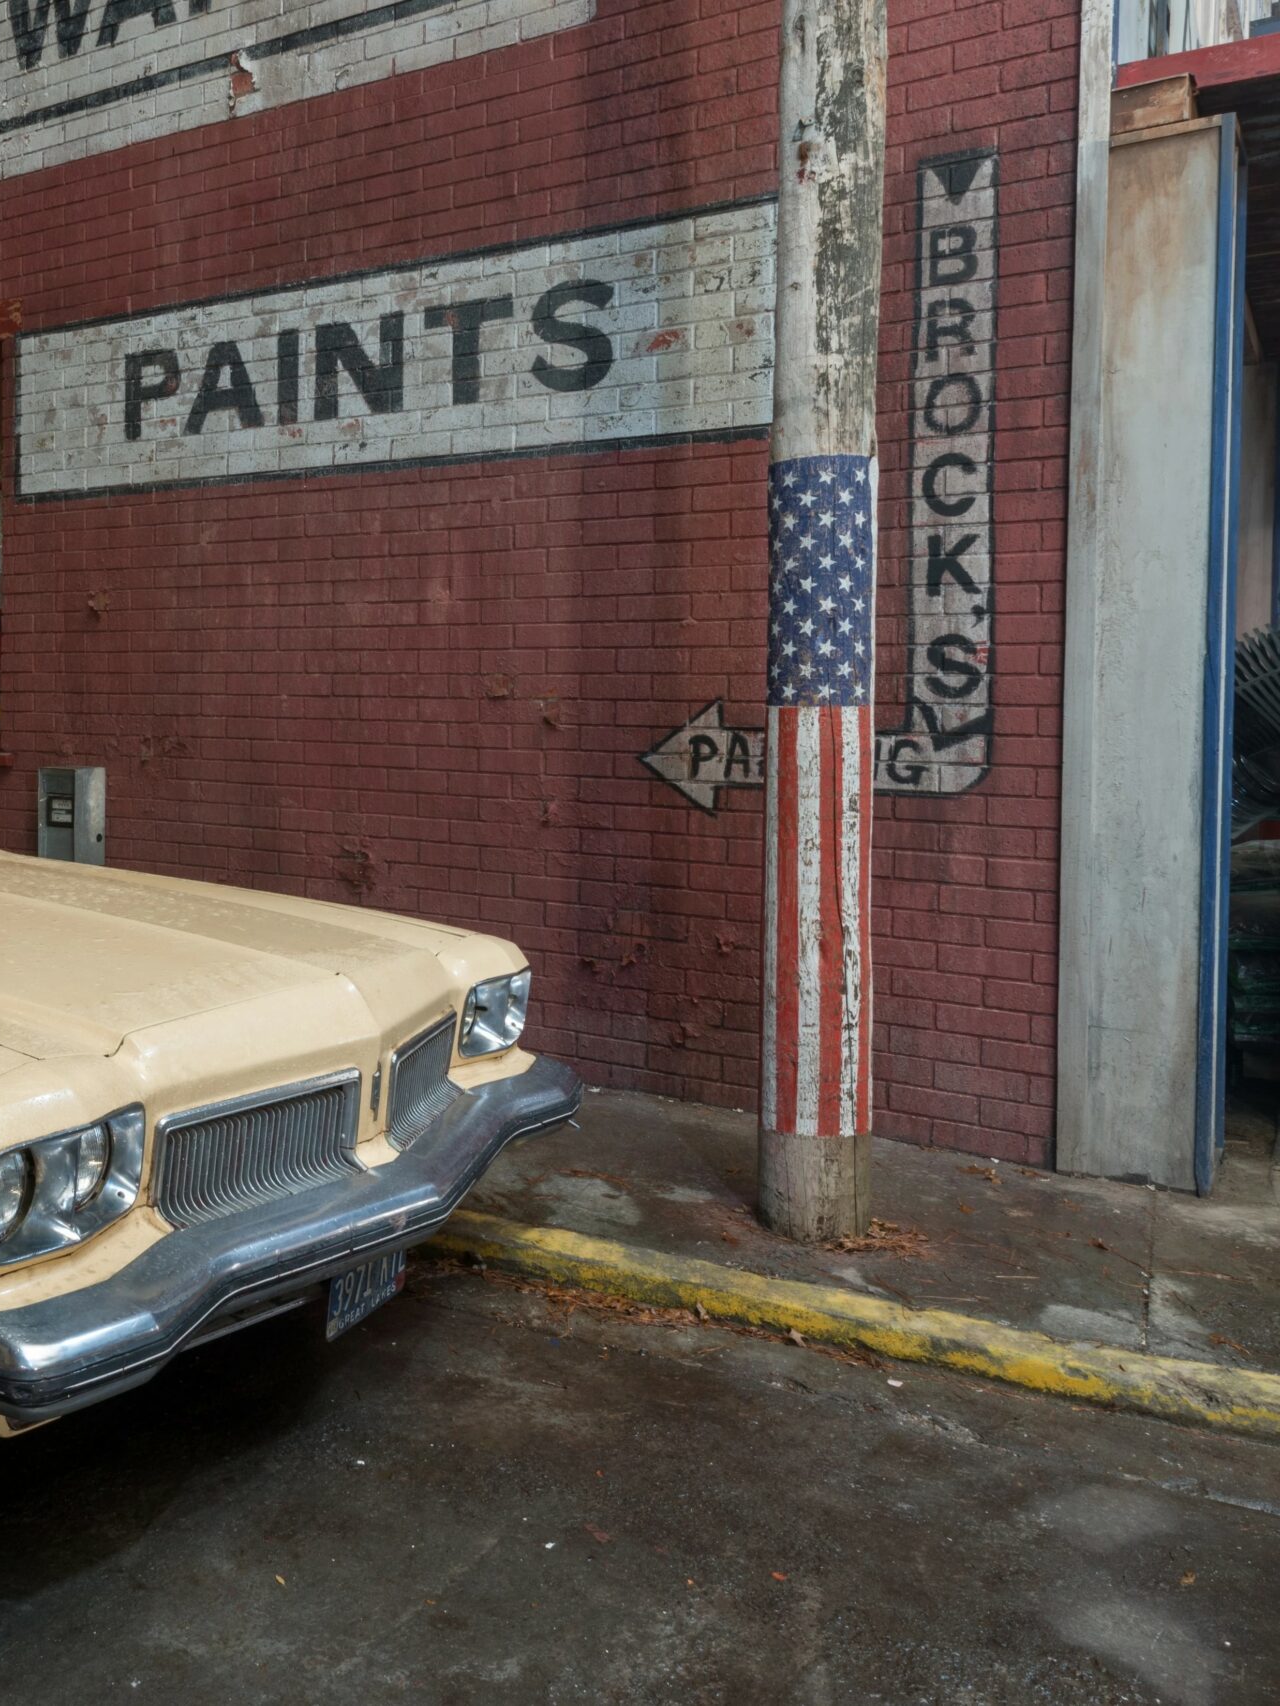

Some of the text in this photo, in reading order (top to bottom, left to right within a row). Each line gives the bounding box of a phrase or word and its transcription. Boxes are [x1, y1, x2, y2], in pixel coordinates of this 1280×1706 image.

[123, 279, 616, 441] PAINTS
[921, 228, 988, 699] BROCK'S
[338, 1303, 365, 1329] GREAT
[371, 1281, 397, 1308] LAKES
